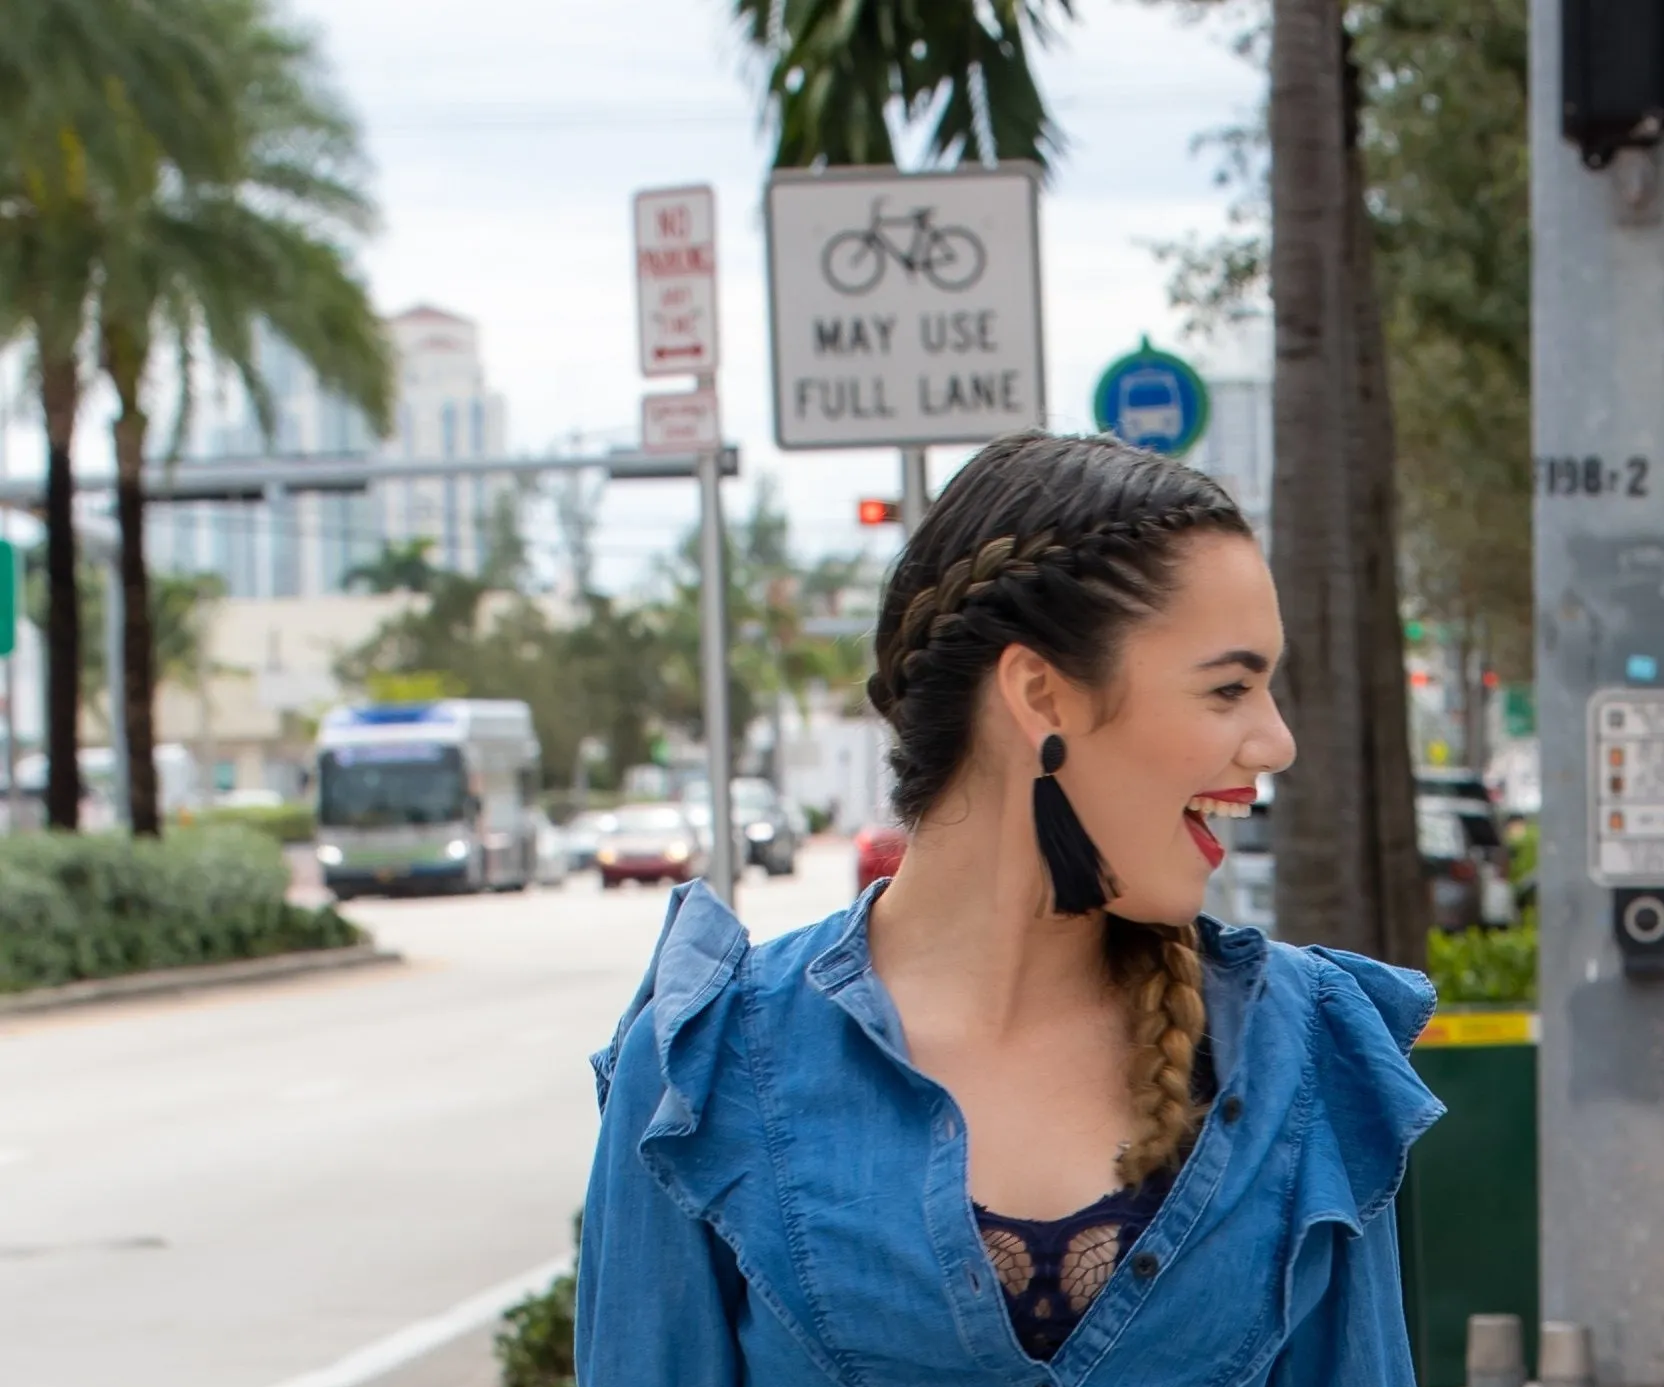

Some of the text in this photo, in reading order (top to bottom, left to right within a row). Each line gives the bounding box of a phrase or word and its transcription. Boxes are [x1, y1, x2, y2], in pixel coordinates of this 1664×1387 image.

[812, 309, 999, 357] MAY USE
[793, 369, 1024, 423] FULL LANE
